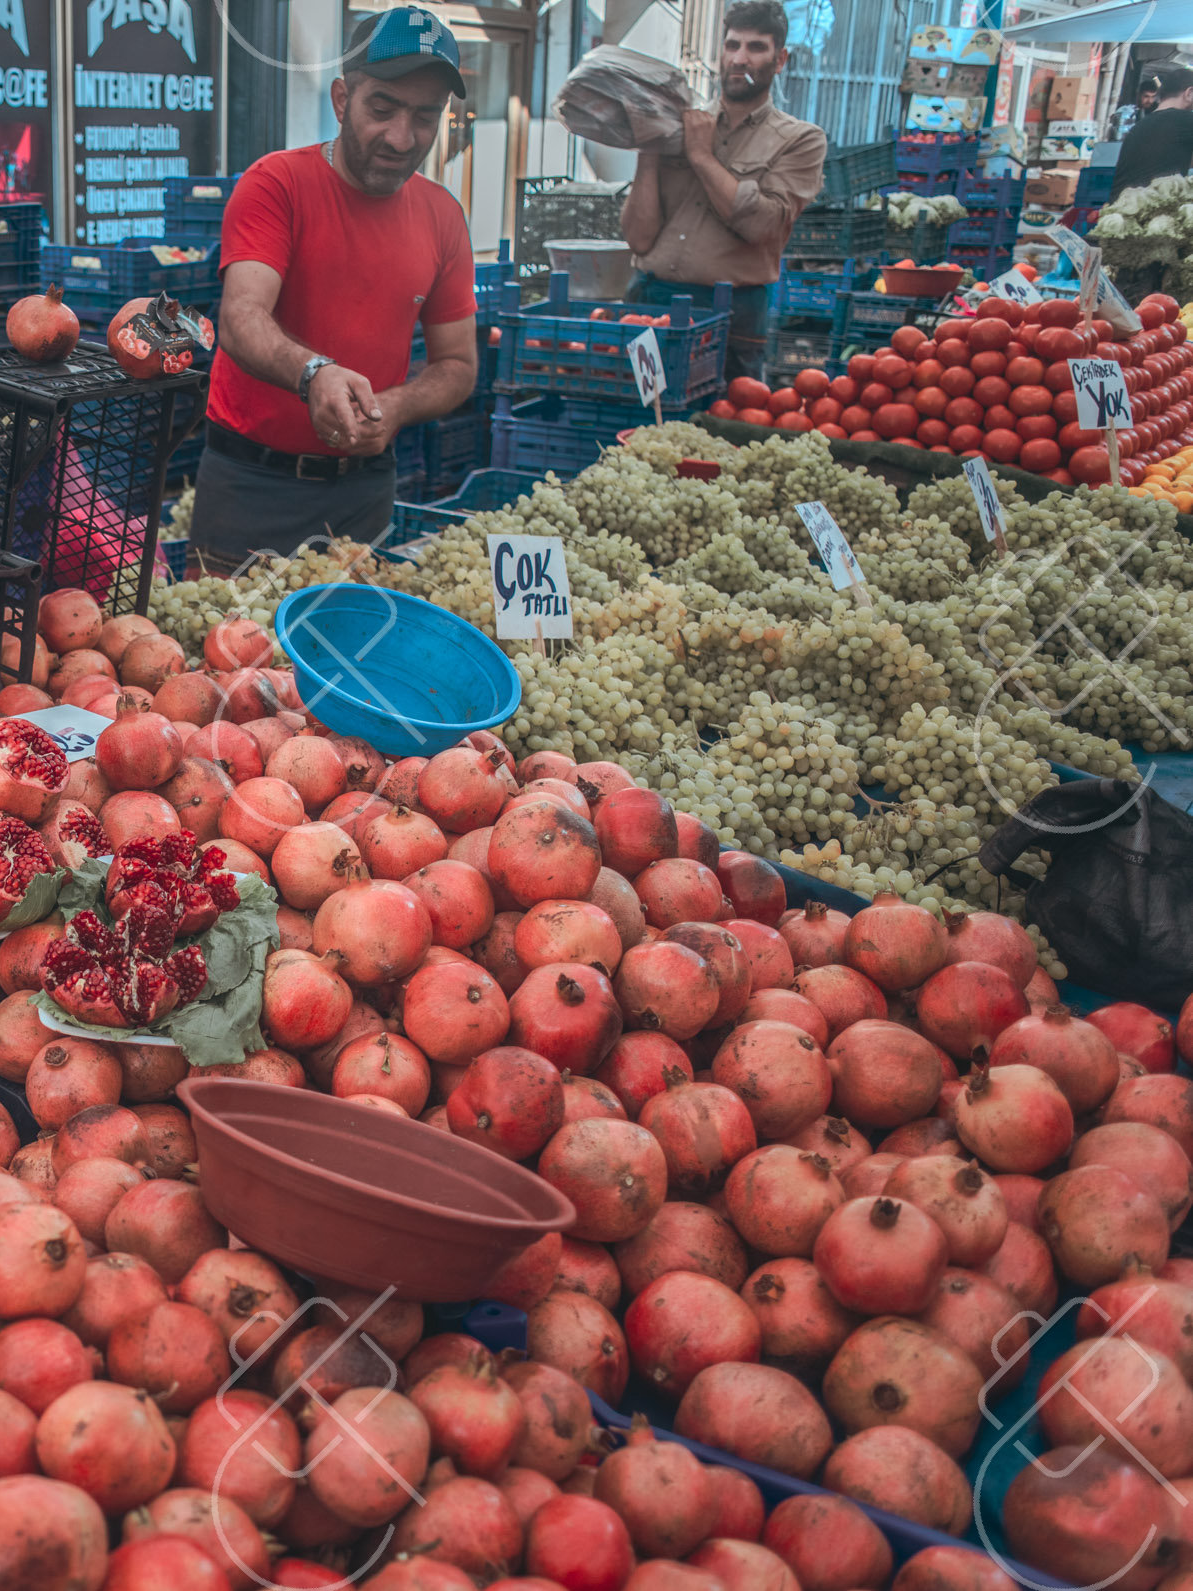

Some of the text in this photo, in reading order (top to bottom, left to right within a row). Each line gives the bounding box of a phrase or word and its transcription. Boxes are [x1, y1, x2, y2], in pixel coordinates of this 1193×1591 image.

[74, 63, 214, 111] İNTERNET C@FE
[1085, 381, 1129, 428] YOK
[494, 542, 557, 611] ÇOK
[522, 593, 568, 616] TATLI
